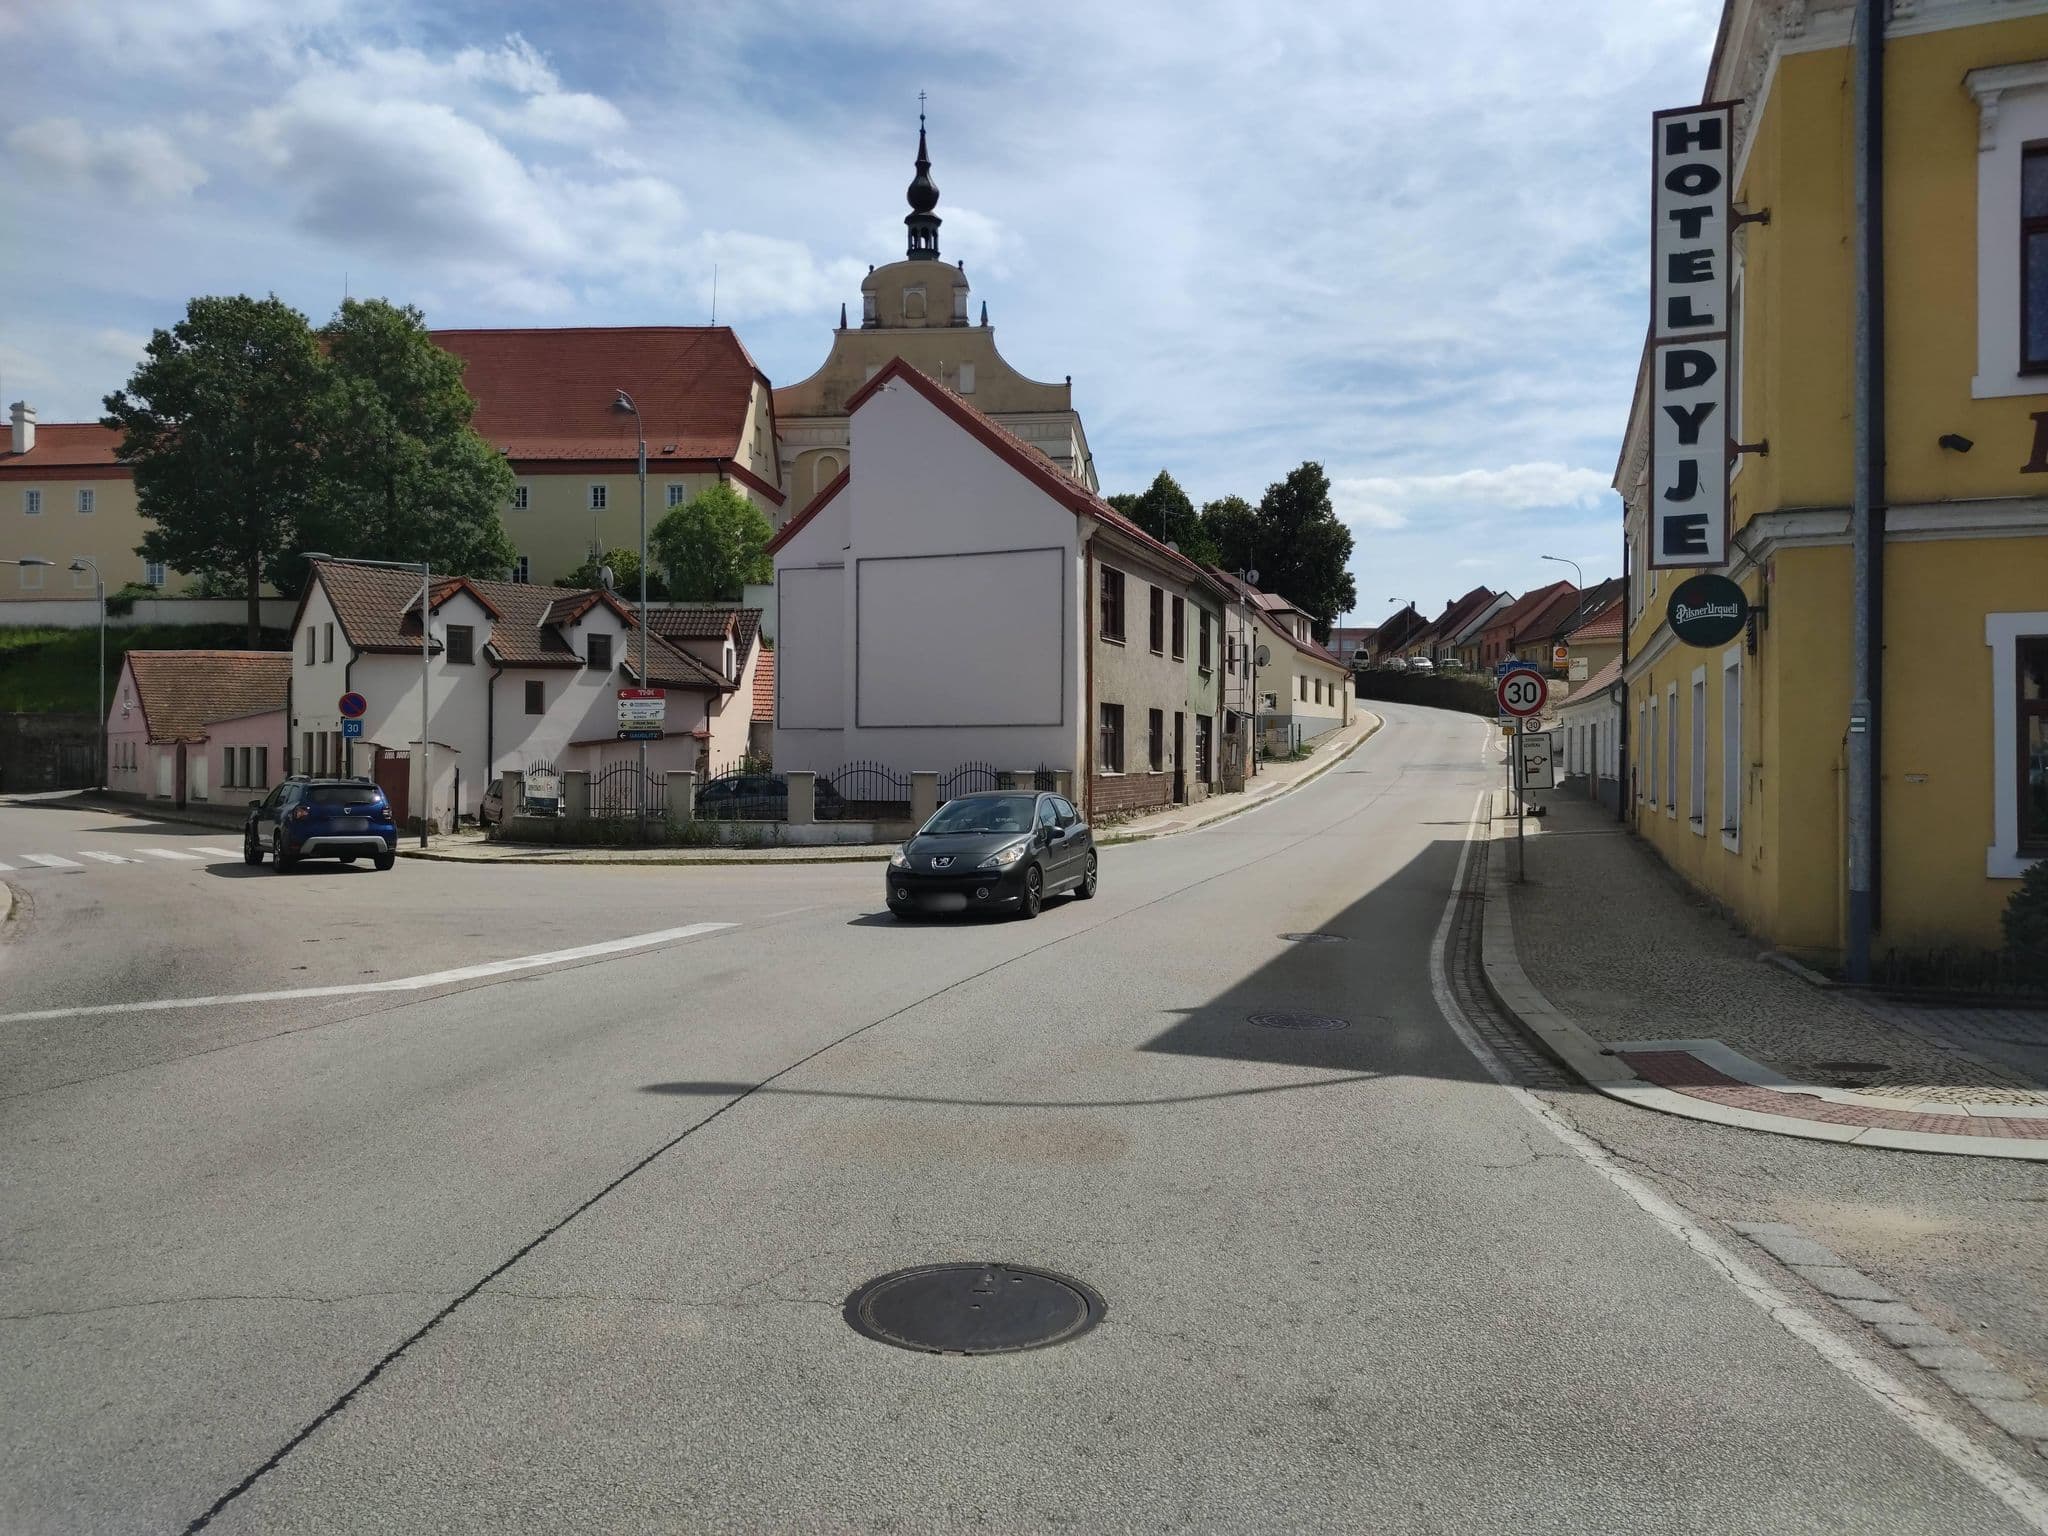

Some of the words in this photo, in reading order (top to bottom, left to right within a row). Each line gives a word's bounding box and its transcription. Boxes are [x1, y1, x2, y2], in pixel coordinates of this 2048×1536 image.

[1665, 118, 1721, 329] HOTEL
[1663, 350, 1718, 556] DYJE
[1676, 604, 1708, 624] Pilsner
[1706, 602, 1738, 618] Urquell
[1508, 682, 1537, 704] 30
[347, 724, 359, 733] 30
